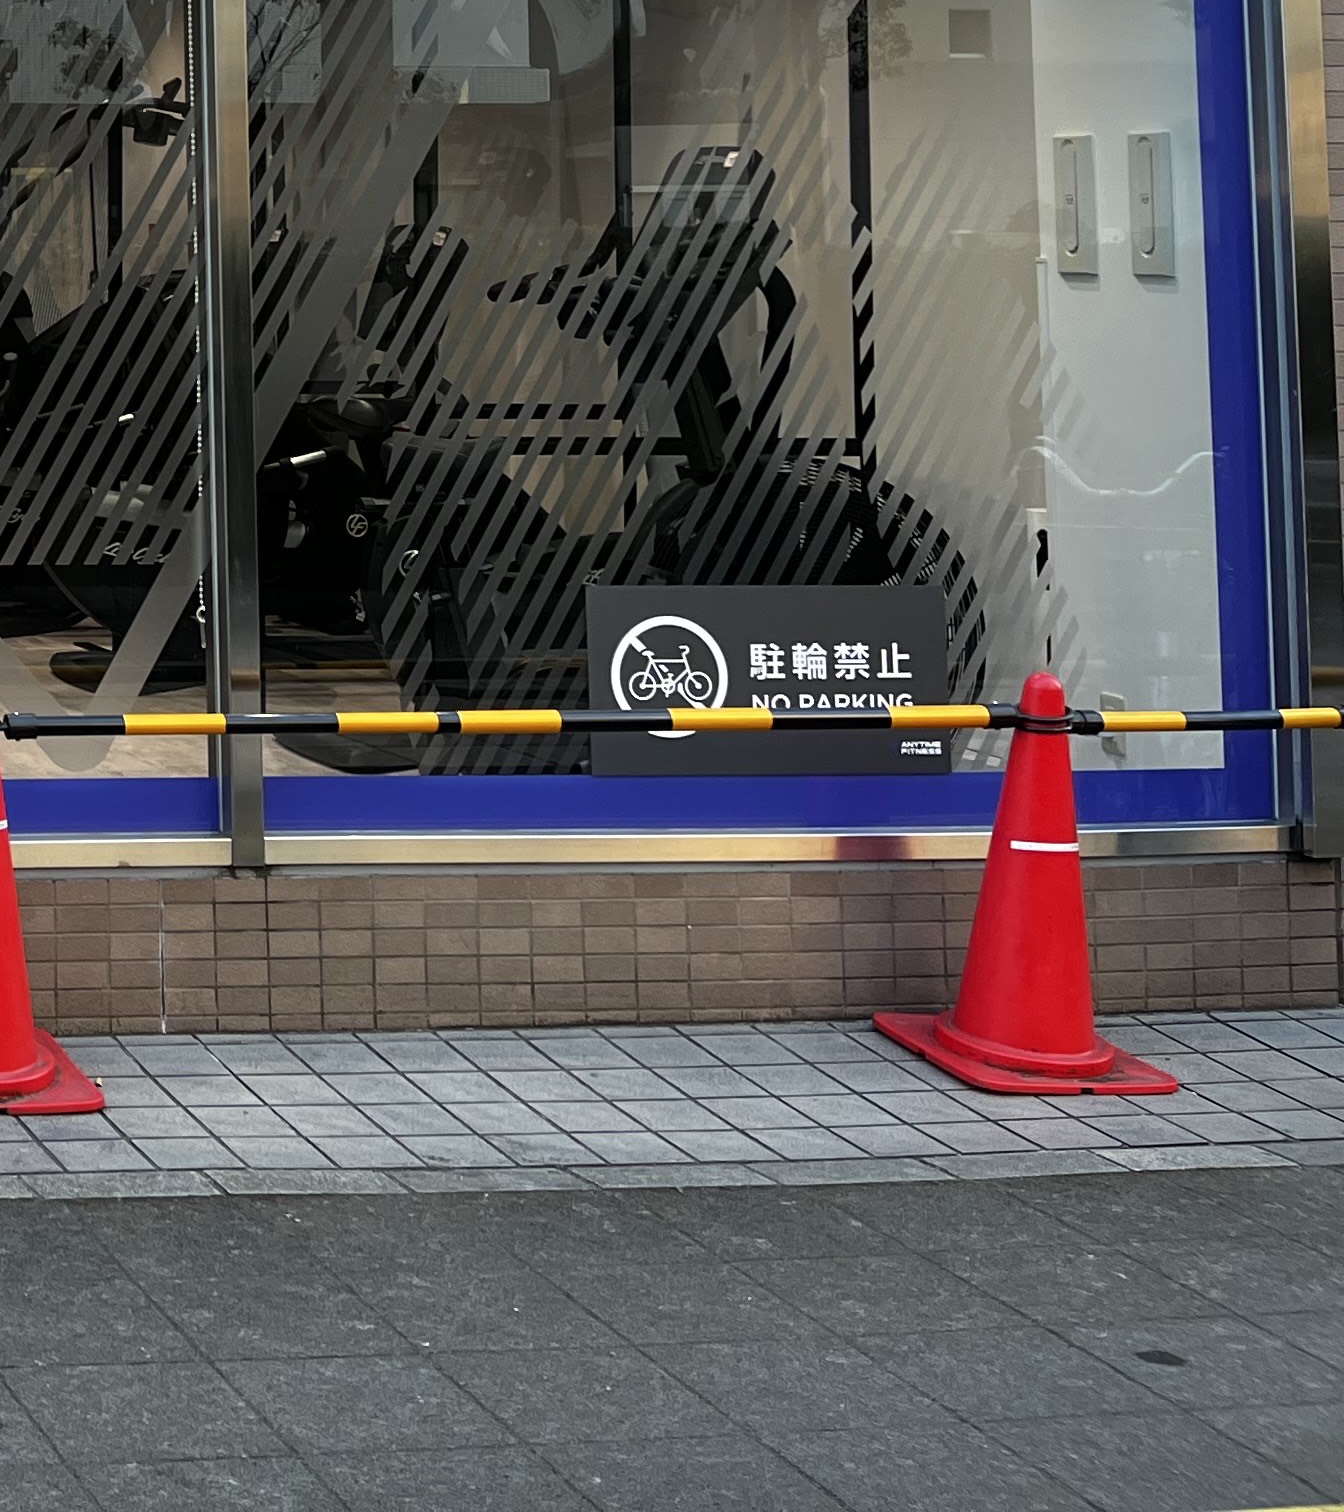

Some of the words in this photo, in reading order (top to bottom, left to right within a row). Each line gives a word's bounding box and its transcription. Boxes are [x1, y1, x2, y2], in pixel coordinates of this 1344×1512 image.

[749, 642, 913, 680] 駐輪禁止
[751, 693, 791, 709] NO
[799, 693, 913, 709] PARKING
[900, 740, 942, 748] ANYTIME
